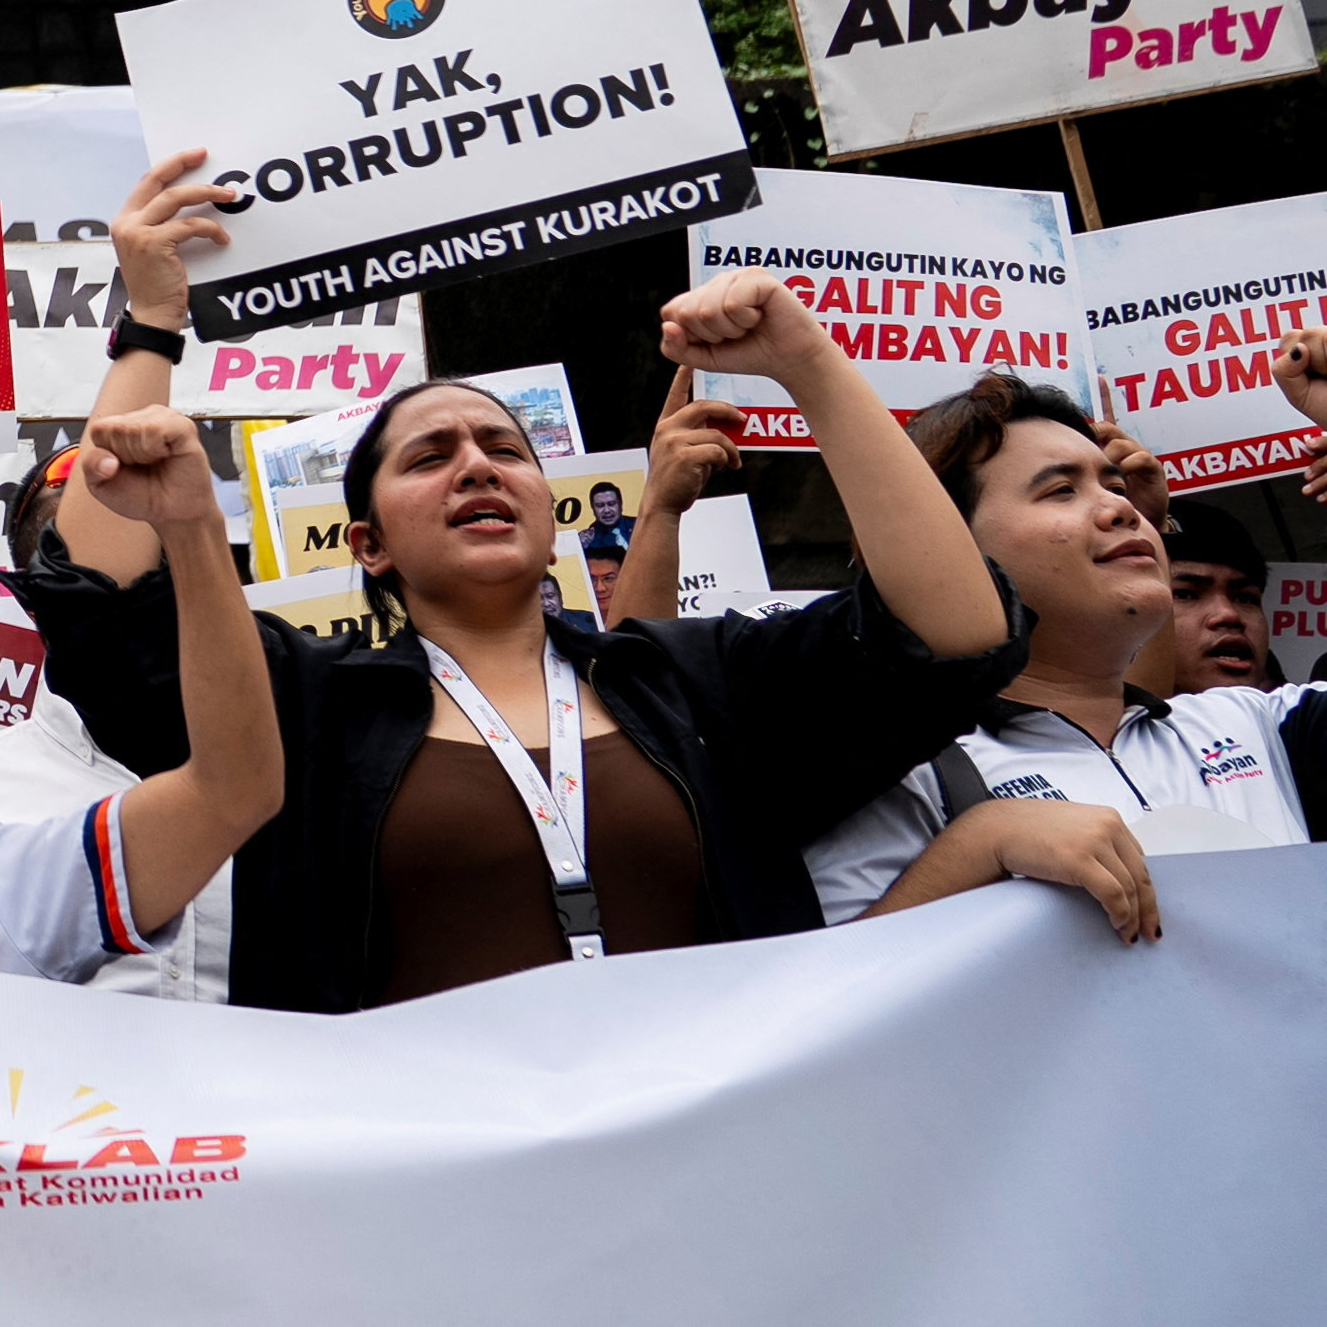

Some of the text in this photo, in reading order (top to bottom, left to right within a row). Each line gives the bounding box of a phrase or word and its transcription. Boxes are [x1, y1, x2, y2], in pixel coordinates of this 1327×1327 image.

[1087, 4, 1284, 80] Party
[338, 48, 502, 118] YAK,
[212, 63, 676, 215] CORRUPTION!
[217, 268, 353, 323] YOUTH
[360, 218, 527, 292] AGAINST
[534, 172, 723, 244] KURAKOT
[704, 244, 1066, 286] BABANGUNGUTIN KAYO NG
[784, 275, 1002, 321] GALIT NG
[1165, 298, 1309, 357] GALIT
[208, 344, 407, 399] Party
[20, 1184, 204, 1207] Katiwalian
[41, 1166, 240, 1190] Komunidad
